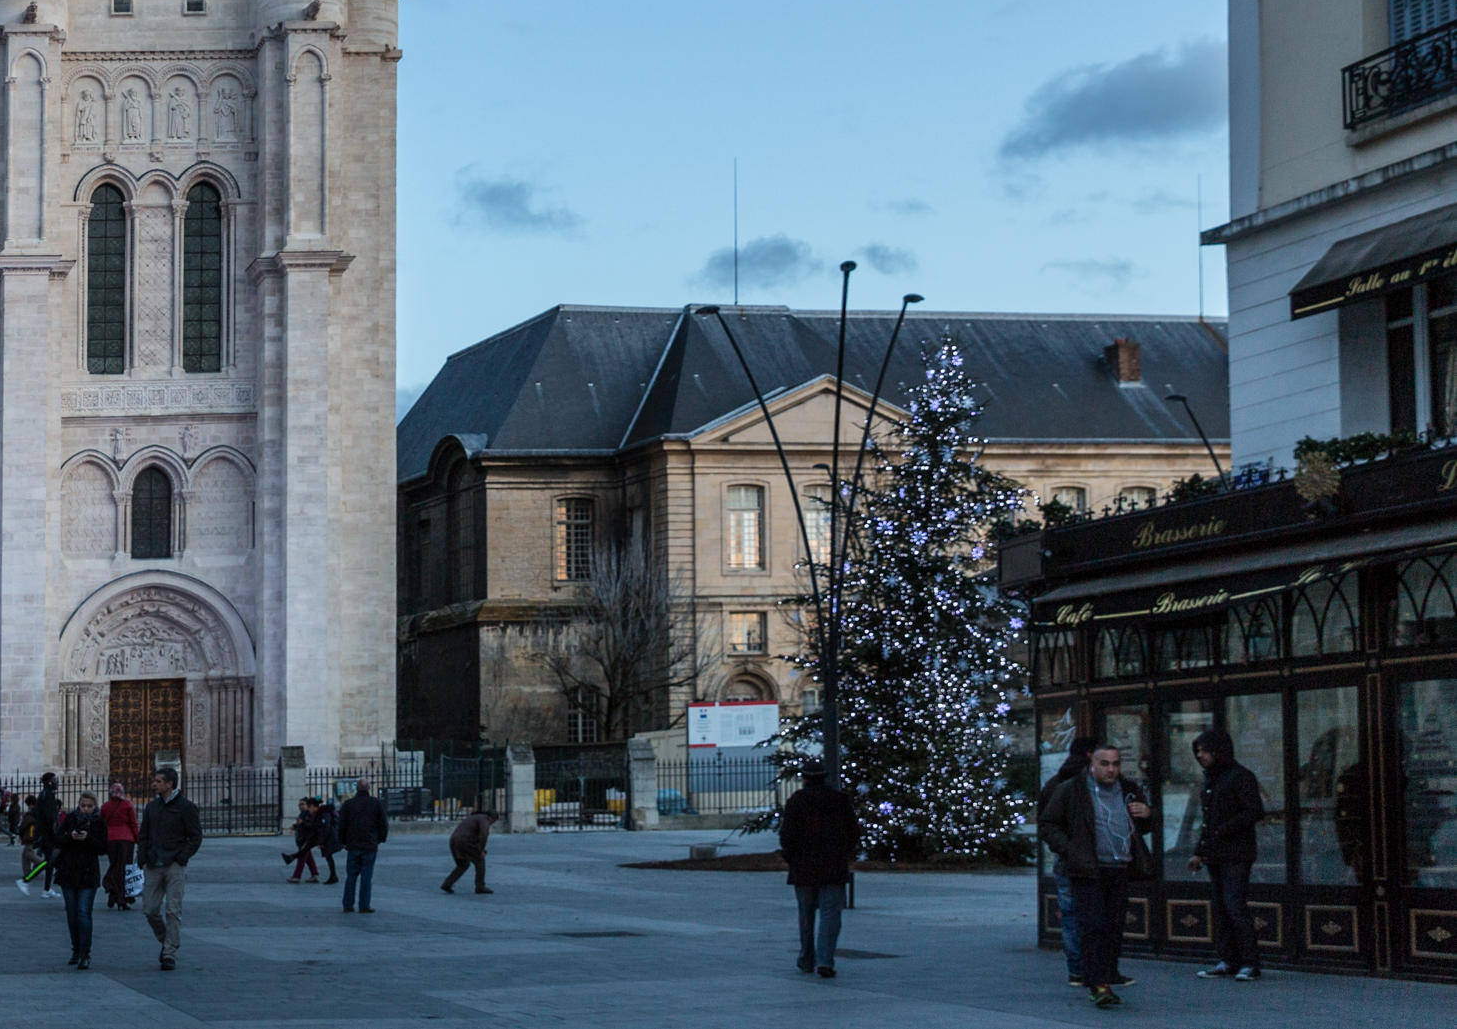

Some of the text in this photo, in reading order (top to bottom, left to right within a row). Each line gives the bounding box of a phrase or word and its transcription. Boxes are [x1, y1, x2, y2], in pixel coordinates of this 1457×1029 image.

[1345, 271, 1385, 297] Salle
[1390, 269, 1413, 284] au
[1132, 515, 1228, 548] Brasserie
[1056, 588, 1230, 628] Café Brasserie
